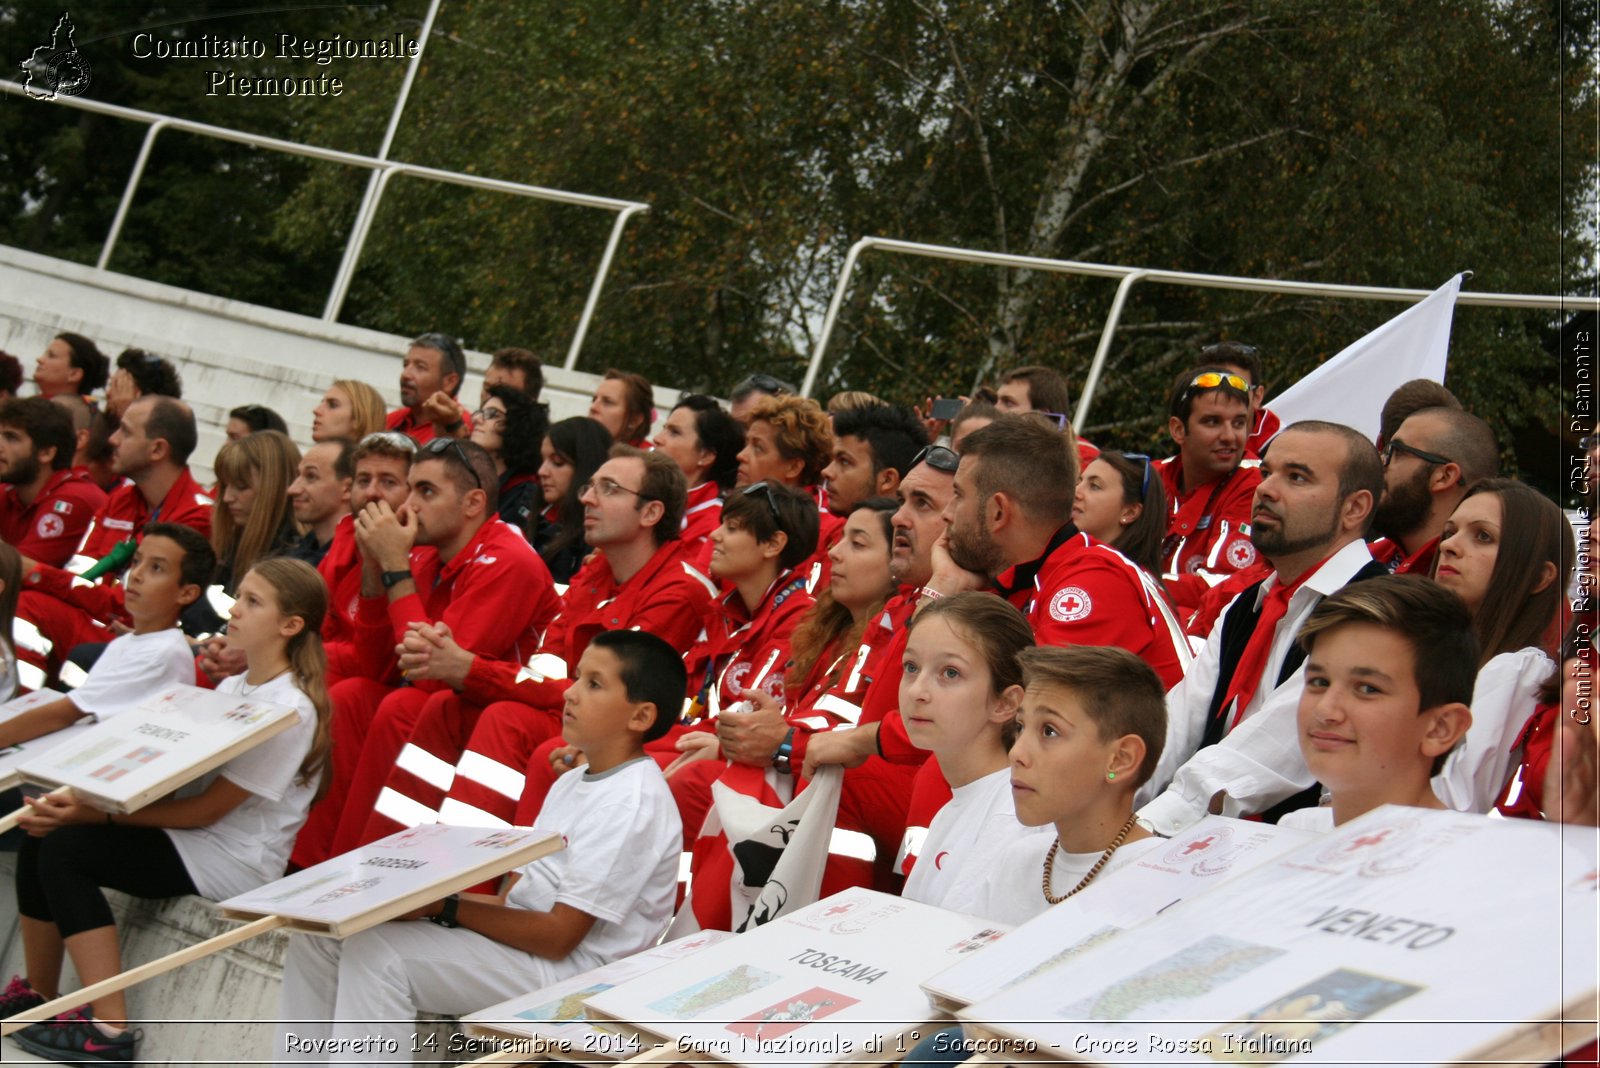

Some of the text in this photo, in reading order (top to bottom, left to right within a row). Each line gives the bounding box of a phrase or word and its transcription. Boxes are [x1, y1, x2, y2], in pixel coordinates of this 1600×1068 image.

[135, 723, 190, 742] PIEMONTE
[1306, 905, 1455, 950] VENETO
[789, 948, 888, 985] TOSCANA
